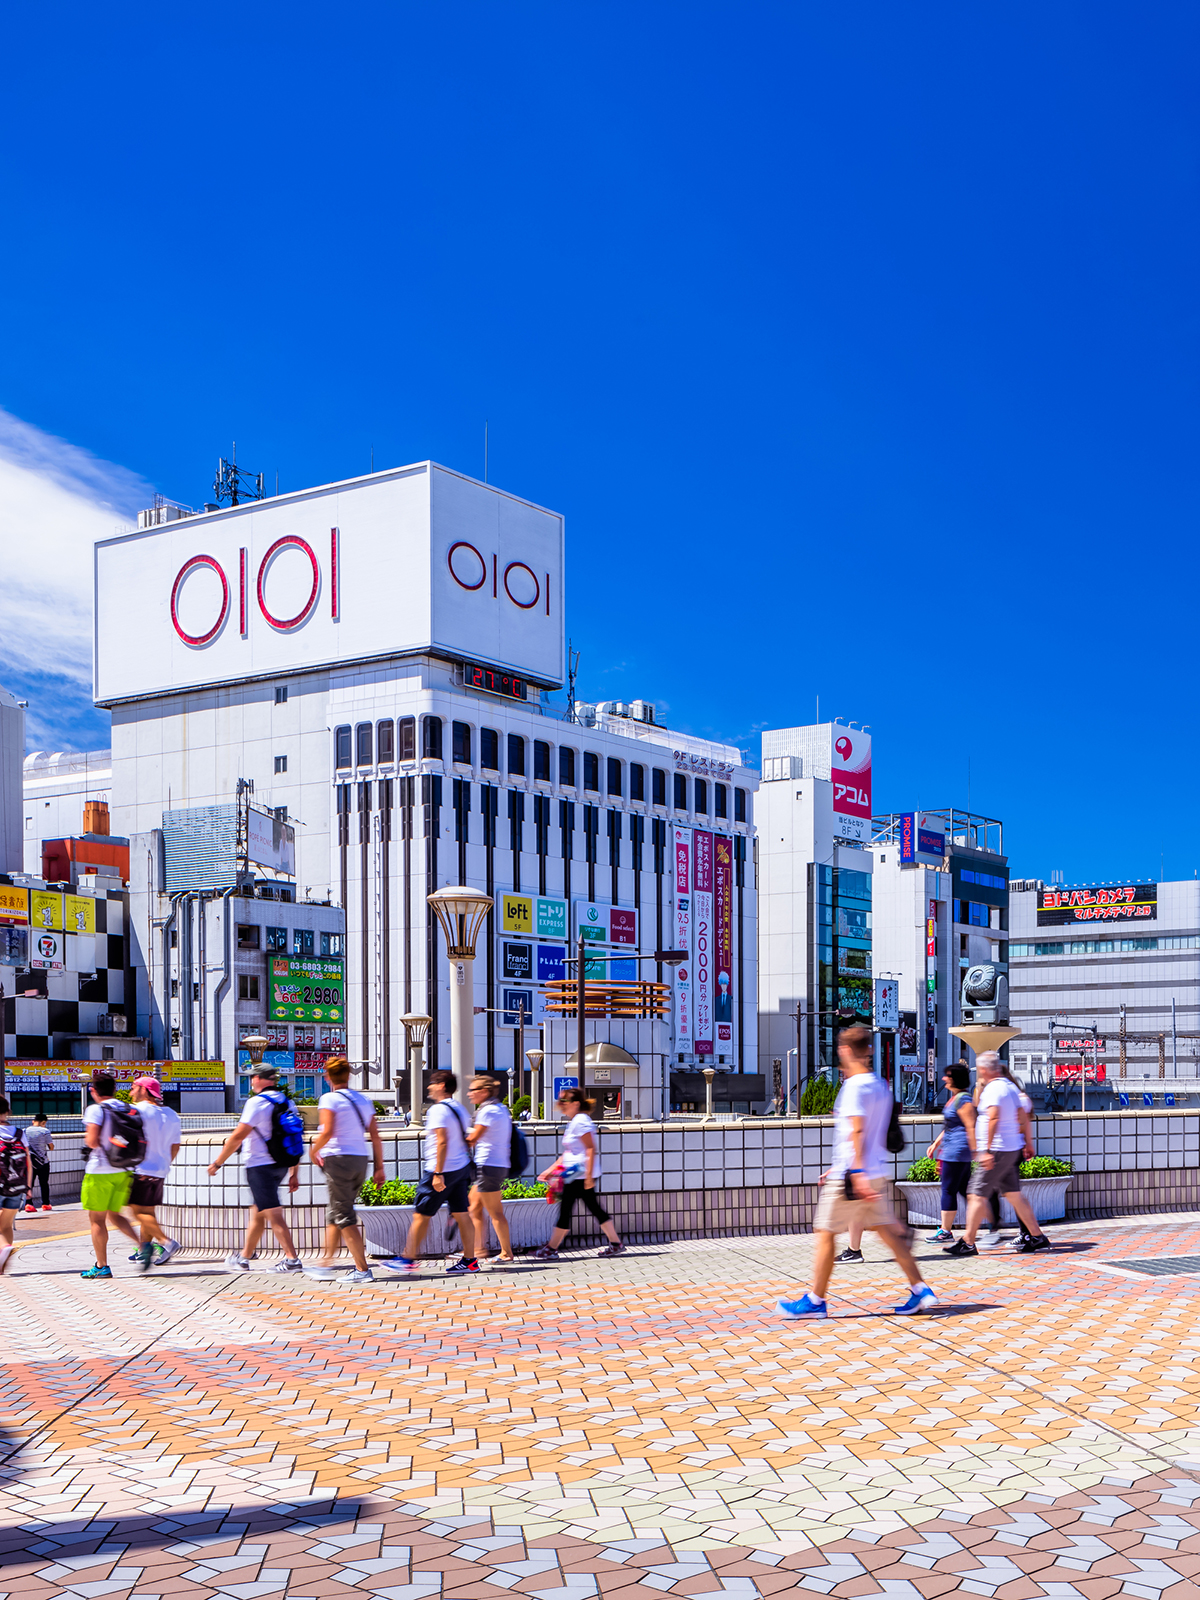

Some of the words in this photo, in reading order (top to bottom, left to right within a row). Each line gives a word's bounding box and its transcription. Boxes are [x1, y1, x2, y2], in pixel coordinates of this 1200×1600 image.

[473, 667, 494, 689] 27
[674, 750, 687, 761] 9F
[690, 754, 735, 774] レストラン
[835, 783, 870, 807] アコム
[842, 825, 852, 835] 8F
[903, 816, 911, 858] PROMISE
[920, 835, 942, 848] PROMISE
[678, 850, 687, 888] 免税店
[1043, 887, 1136, 908] ヨドバシカメラ
[538, 904, 563, 918] ニトリ
[716, 867, 724, 967] エポスカードデビュー
[1073, 905, 1151, 920] マルチメディア上野
[539, 919, 563, 928] EXPRESS
[612, 923, 623, 931] Food
[290, 962, 342, 973] 03-6803-2984
[539, 957, 564, 967] PLAZA
[547, 972, 555, 980] 4F
